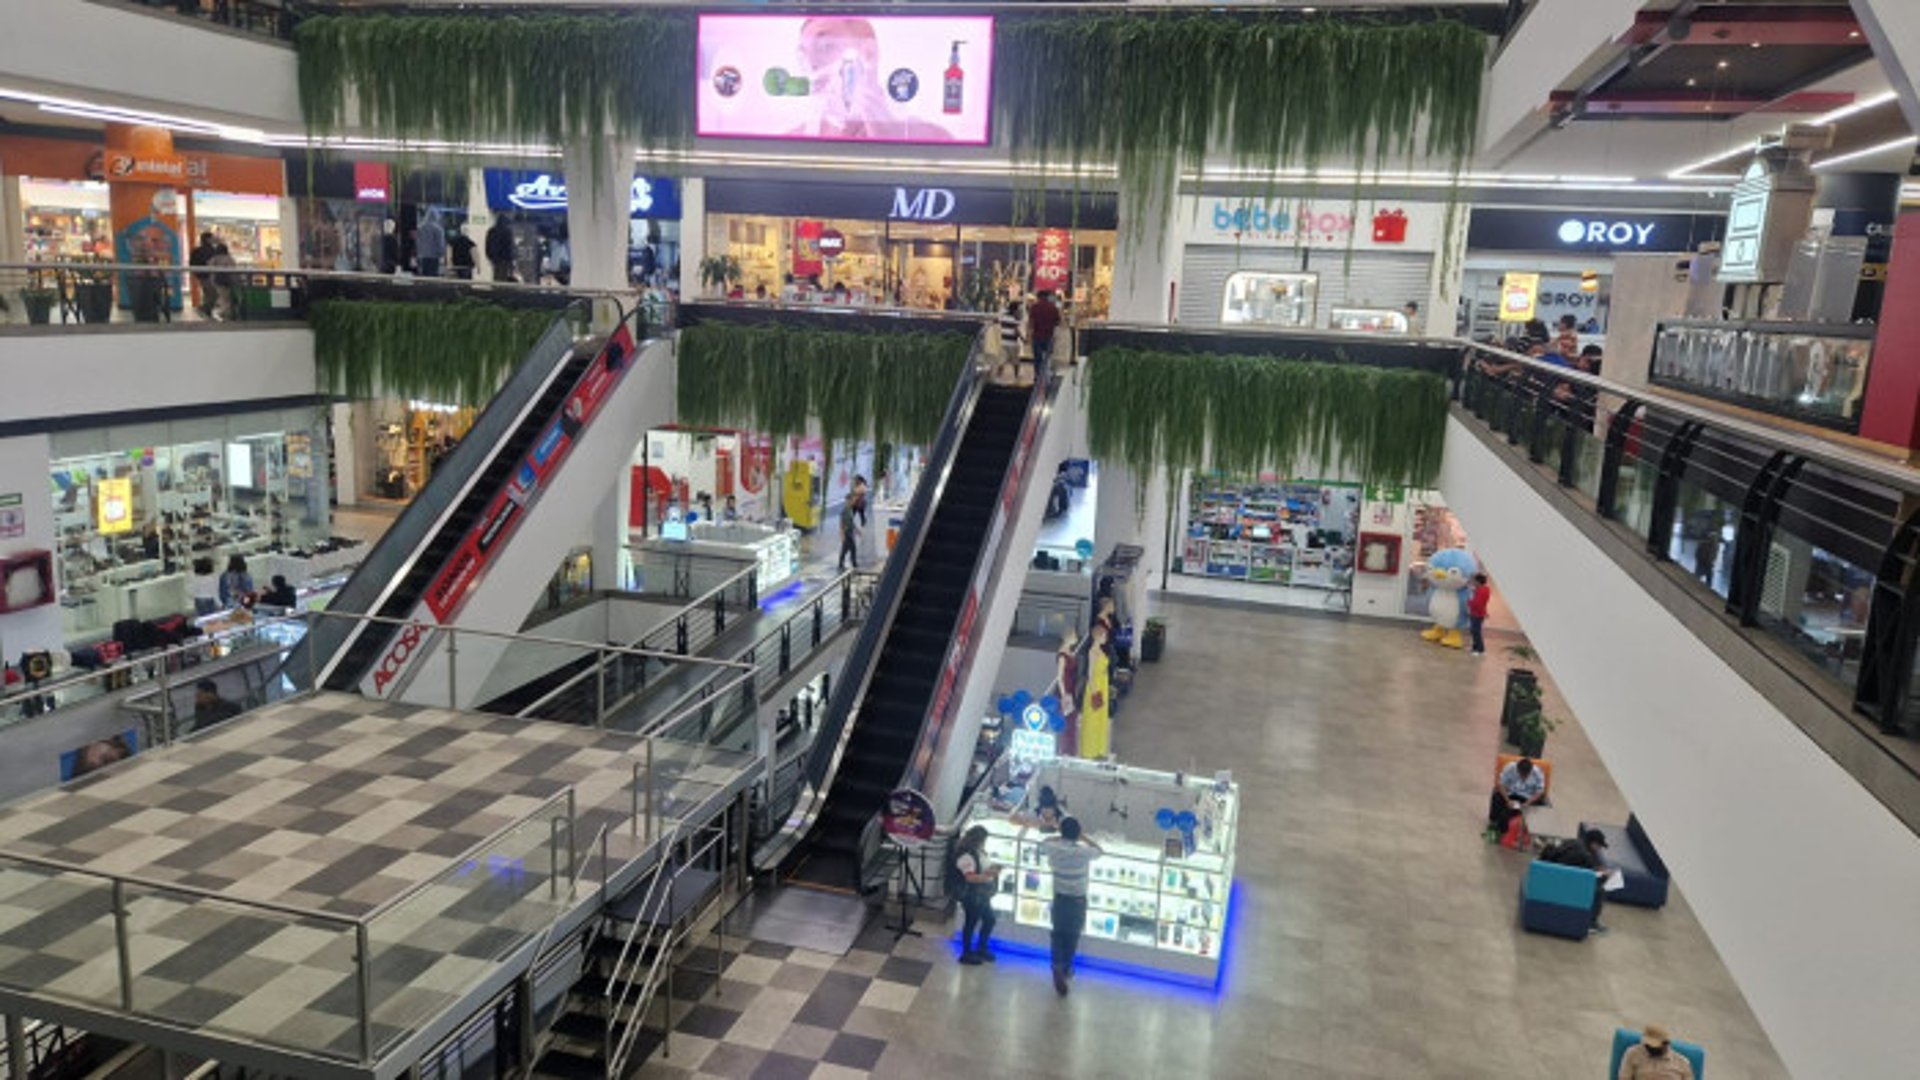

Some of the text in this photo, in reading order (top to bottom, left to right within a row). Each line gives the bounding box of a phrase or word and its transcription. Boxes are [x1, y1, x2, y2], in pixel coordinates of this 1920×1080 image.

[888, 186, 955, 220] MD
[1587, 220, 1655, 245] ROY
[1555, 292, 1595, 307] ROY
[373, 618, 430, 696] ACOSA
